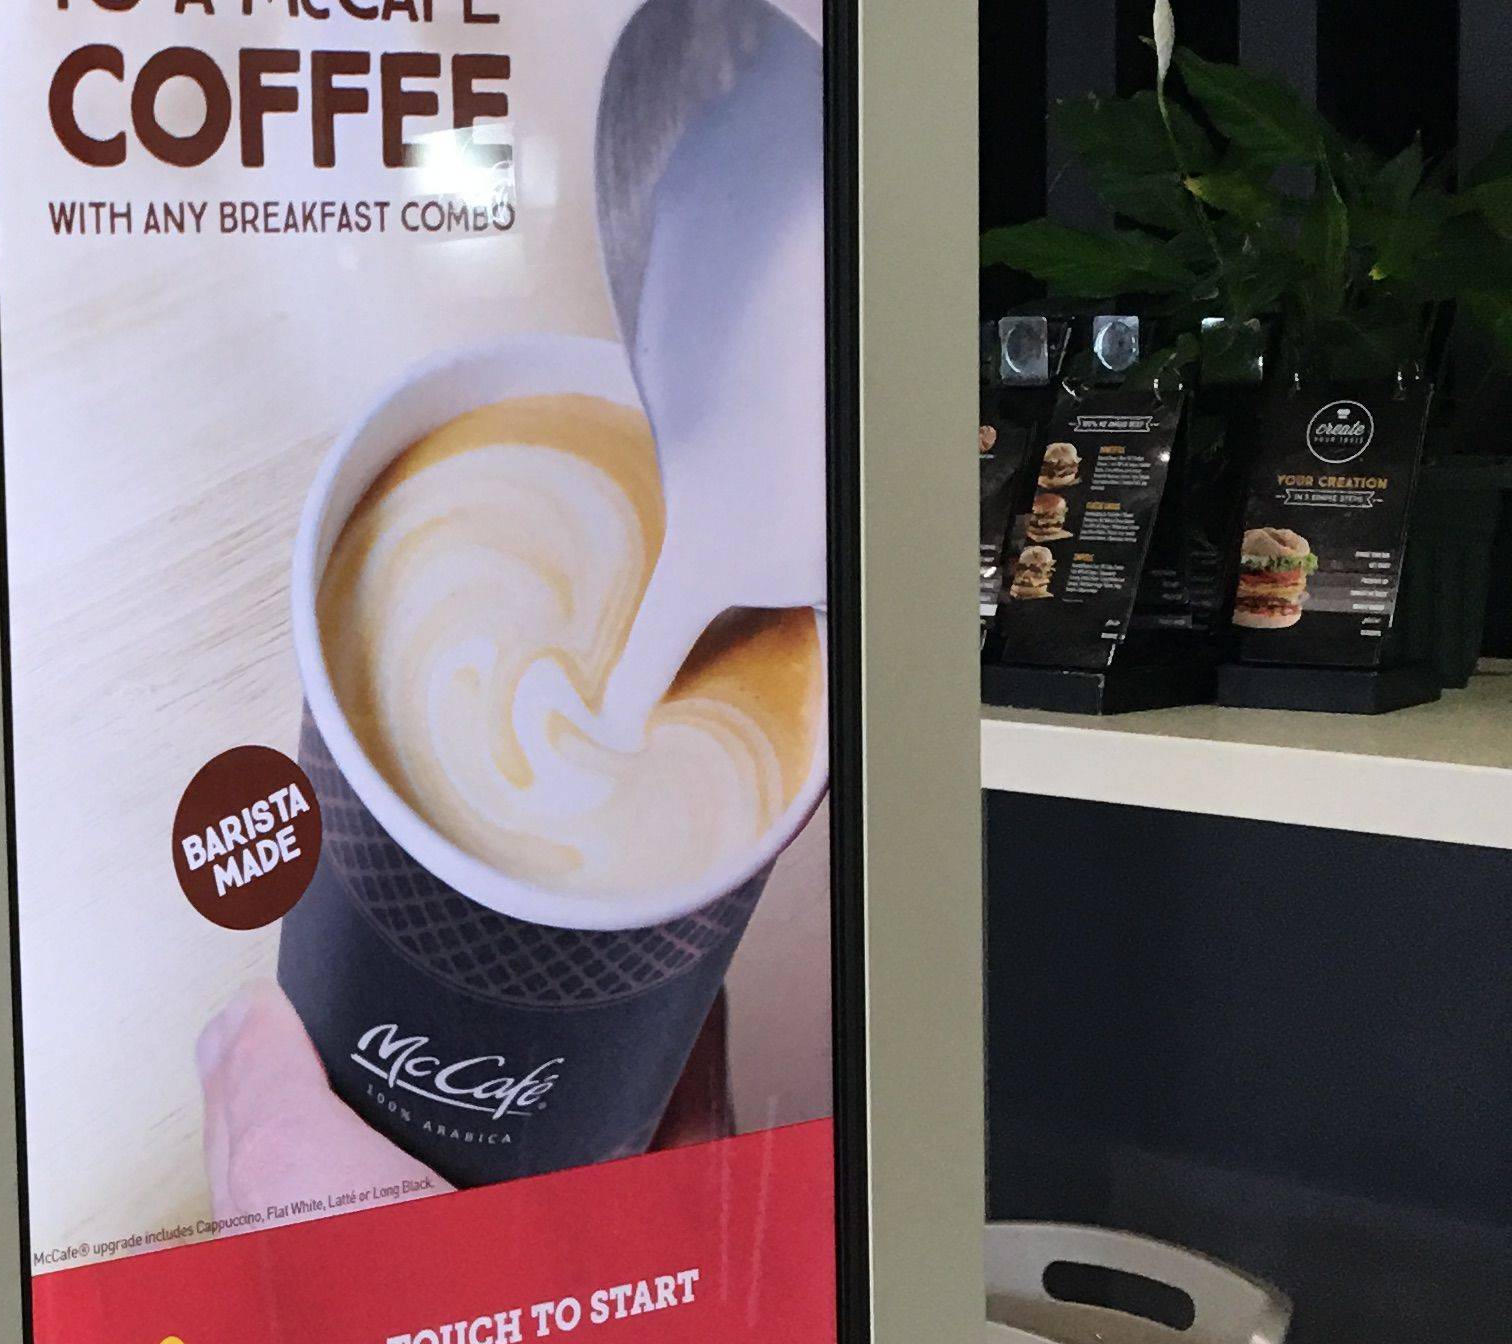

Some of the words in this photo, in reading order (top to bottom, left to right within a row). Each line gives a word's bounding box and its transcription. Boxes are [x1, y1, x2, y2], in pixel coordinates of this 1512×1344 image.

[48, 43, 514, 169] COFFEE
[48, 201, 133, 235] WITH
[143, 201, 208, 234] ANY
[219, 201, 390, 234] BREAKFAST
[401, 201, 516, 232] COMBO
[1315, 420, 1366, 436] create
[1318, 475, 1389, 490] CREATION
[181, 782, 311, 871] BARISTA
[212, 824, 302, 897] MADE
[423, 1120, 512, 1145] ARABICA
[93, 1234, 143, 1257] upgrade
[145, 1226, 194, 1245] includes
[267, 1204, 289, 1220] Flat
[358, 1190, 371, 1202] or
[373, 1184, 400, 1200] Long
[531, 1296, 581, 1338] TO
[590, 1268, 700, 1325] START
